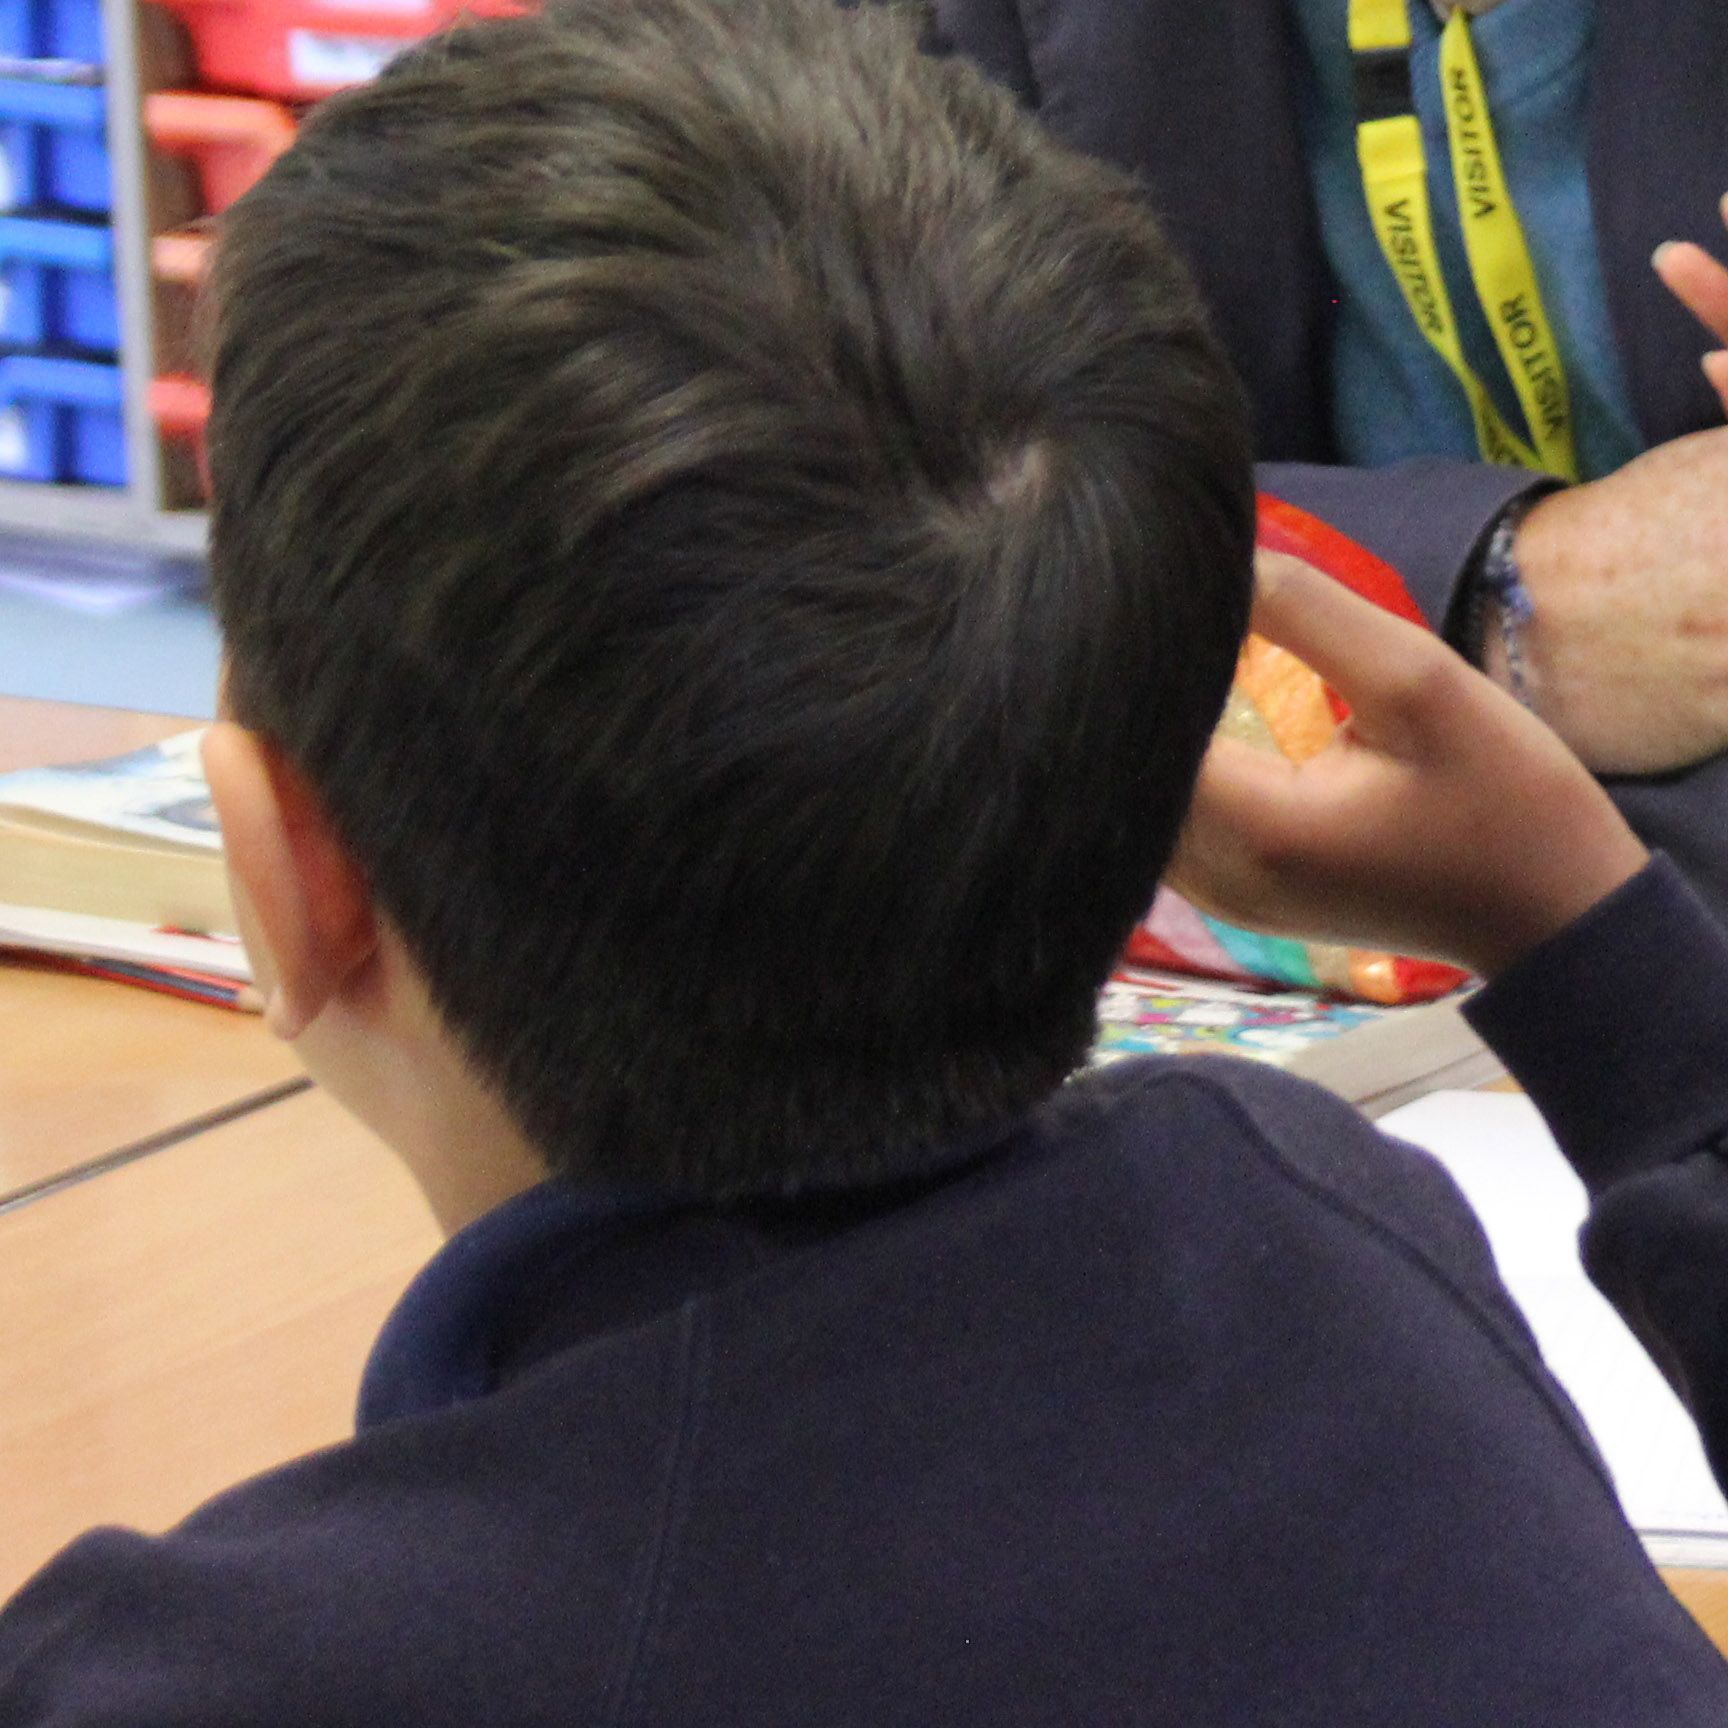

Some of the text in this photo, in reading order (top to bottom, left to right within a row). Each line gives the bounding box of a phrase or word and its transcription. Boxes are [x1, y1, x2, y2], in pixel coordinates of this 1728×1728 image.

[1450, 67, 1498, 219] VISITOR
[1384, 197, 1444, 333] VISITOR
[1499, 292, 1568, 441] VISITOR
